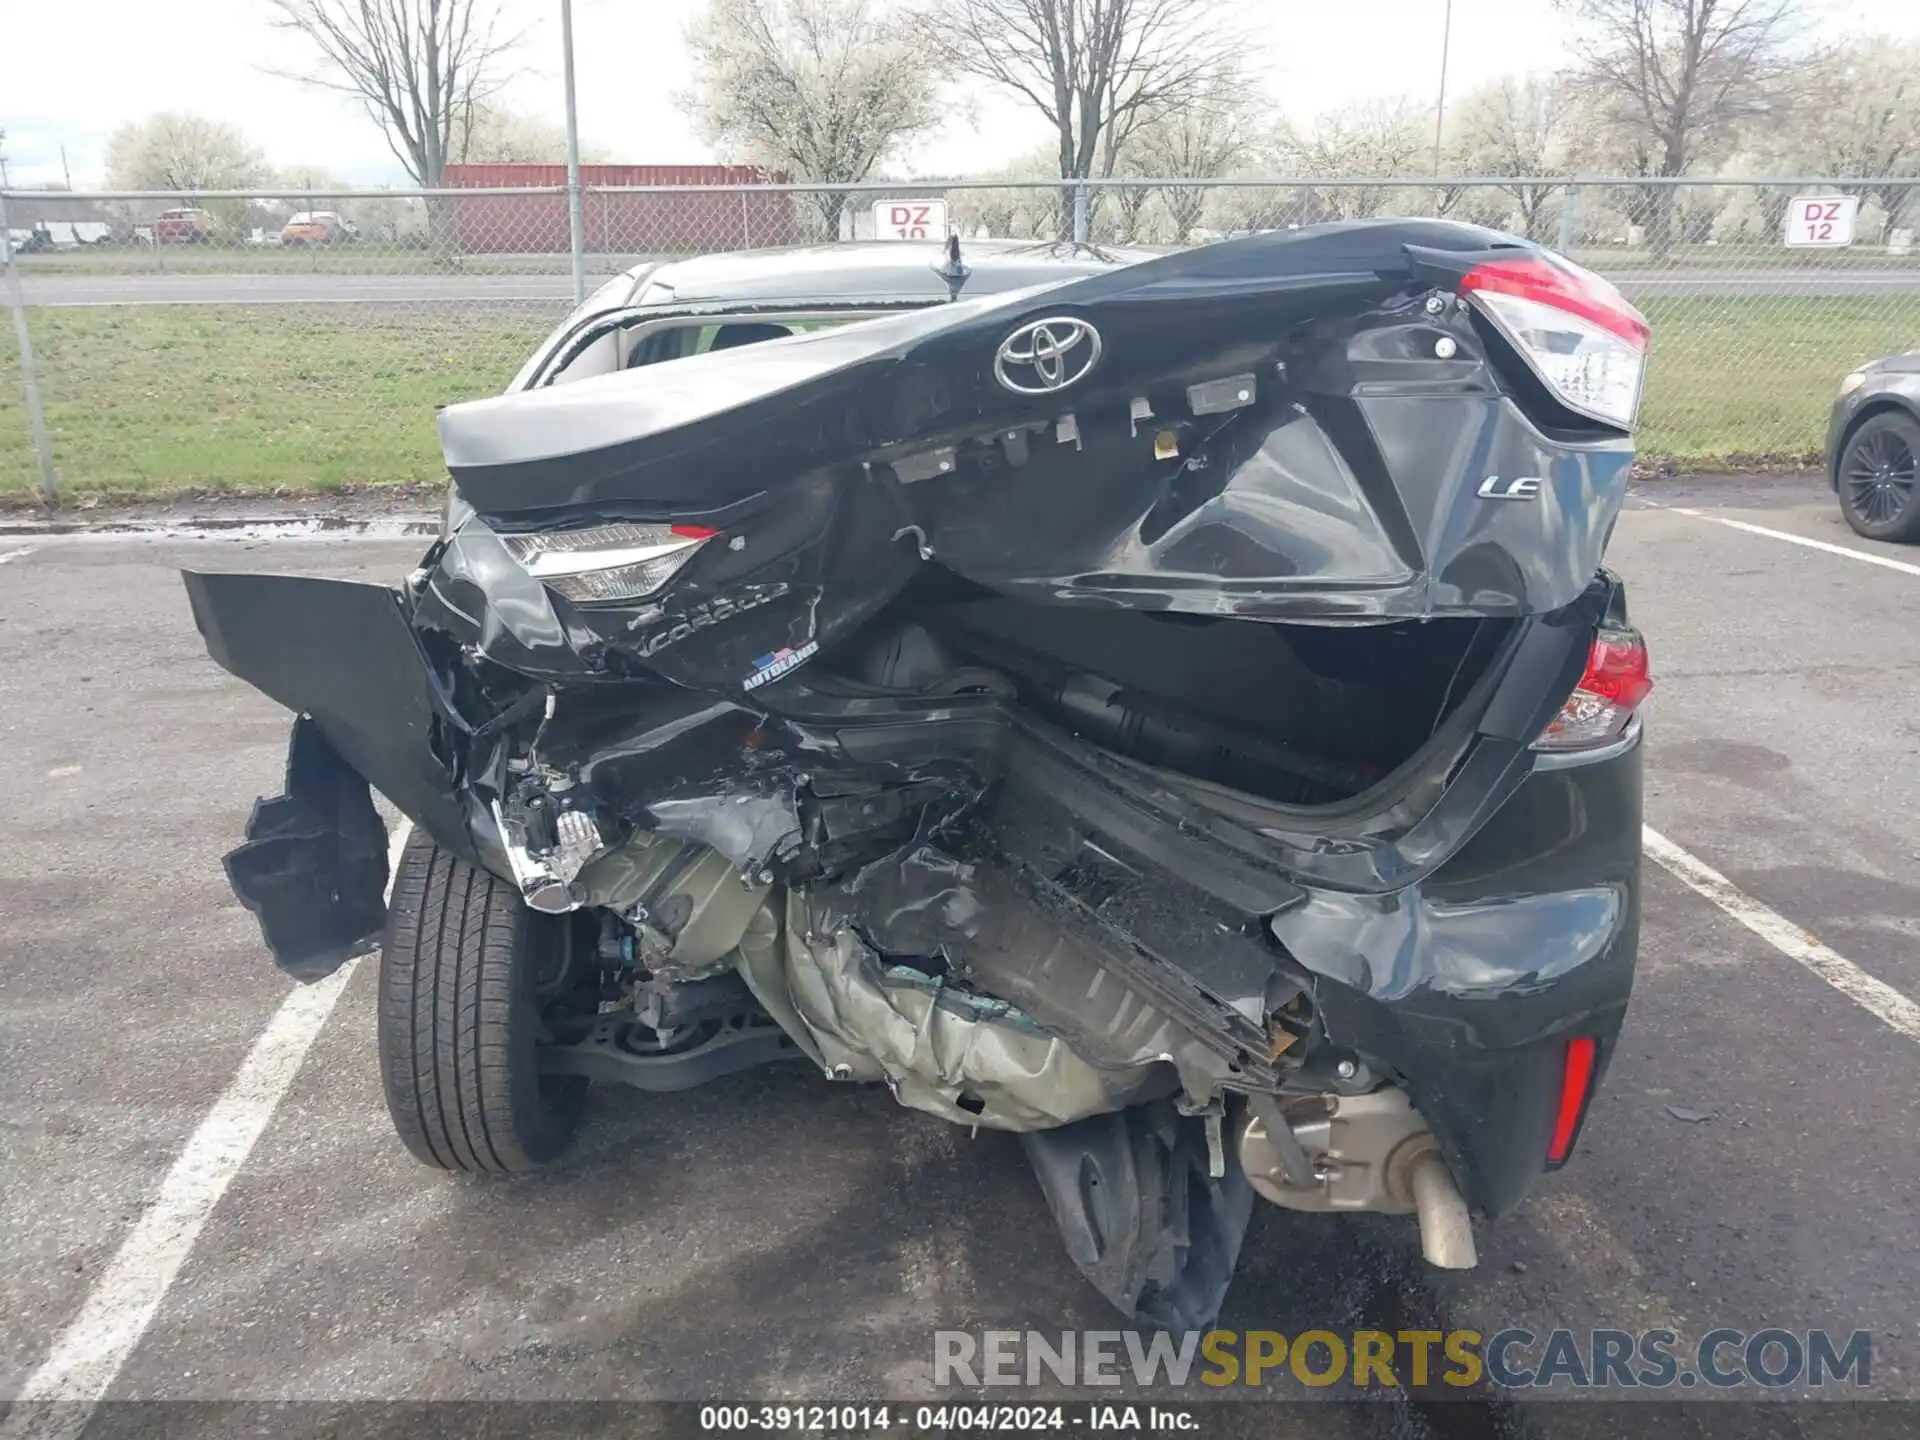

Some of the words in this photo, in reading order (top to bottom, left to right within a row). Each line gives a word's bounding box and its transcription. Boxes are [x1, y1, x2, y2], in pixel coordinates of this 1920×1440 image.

[890, 206, 931, 226] DZ
[1803, 203, 1841, 222] DZ
[1806, 223, 1833, 241] 12
[1476, 475, 1544, 500] LE
[742, 640, 820, 692] AUTOLAND
